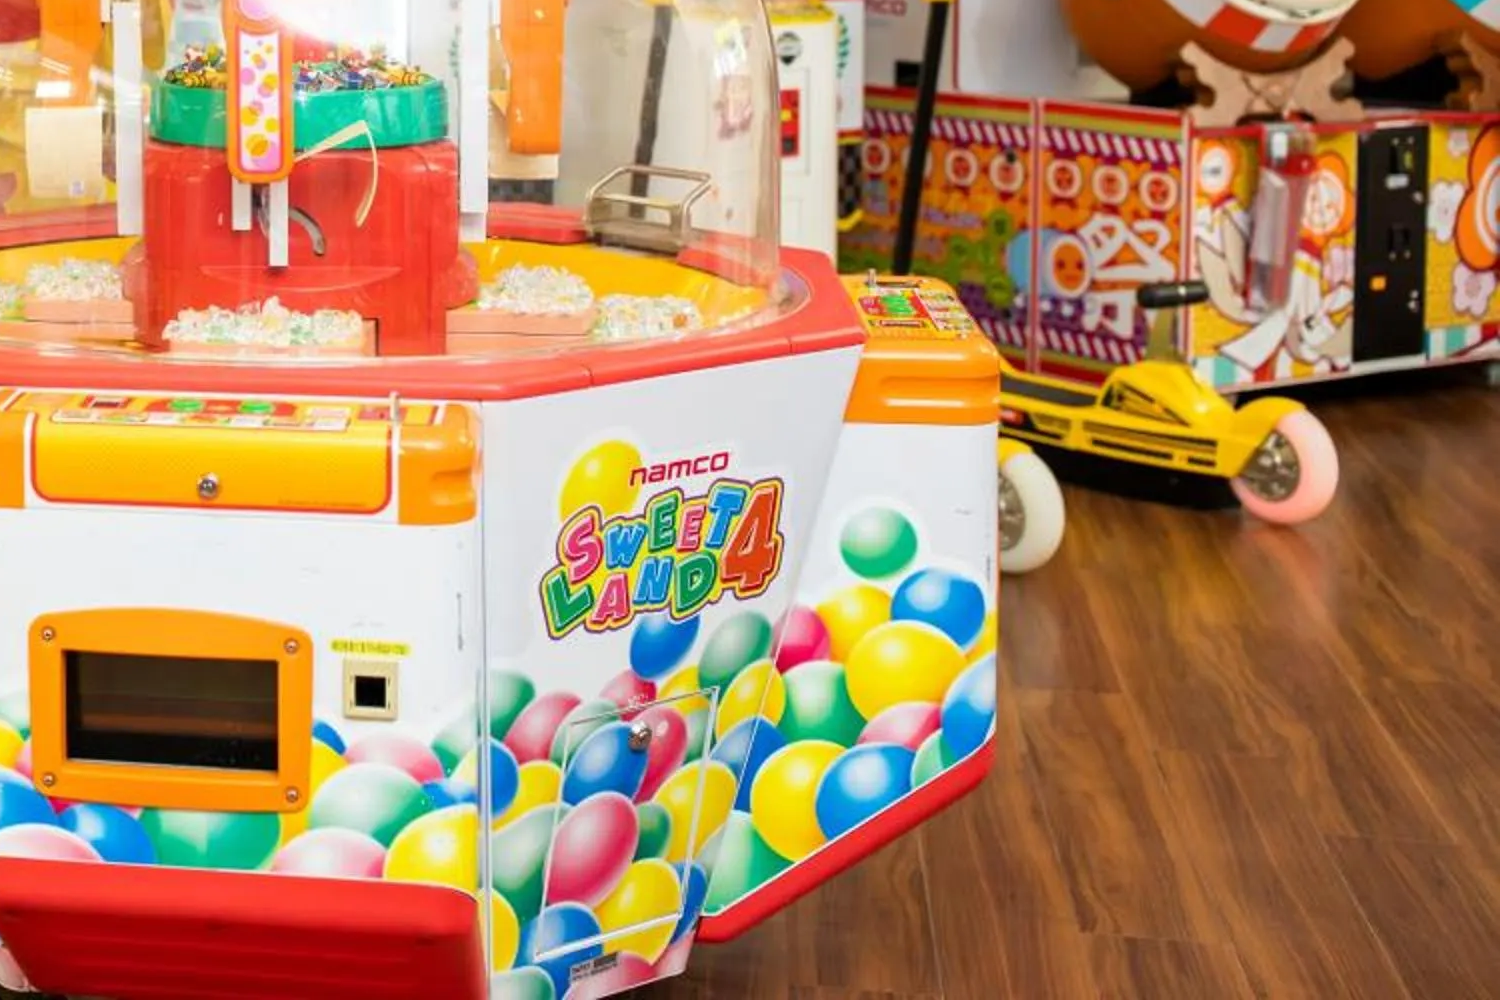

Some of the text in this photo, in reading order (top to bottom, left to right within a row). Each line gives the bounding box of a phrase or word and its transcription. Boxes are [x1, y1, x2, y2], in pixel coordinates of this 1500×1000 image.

[628, 451, 729, 487] namco
[563, 486, 748, 585] SWEET
[719, 485, 776, 593] 4
[546, 551, 717, 633] LAND
